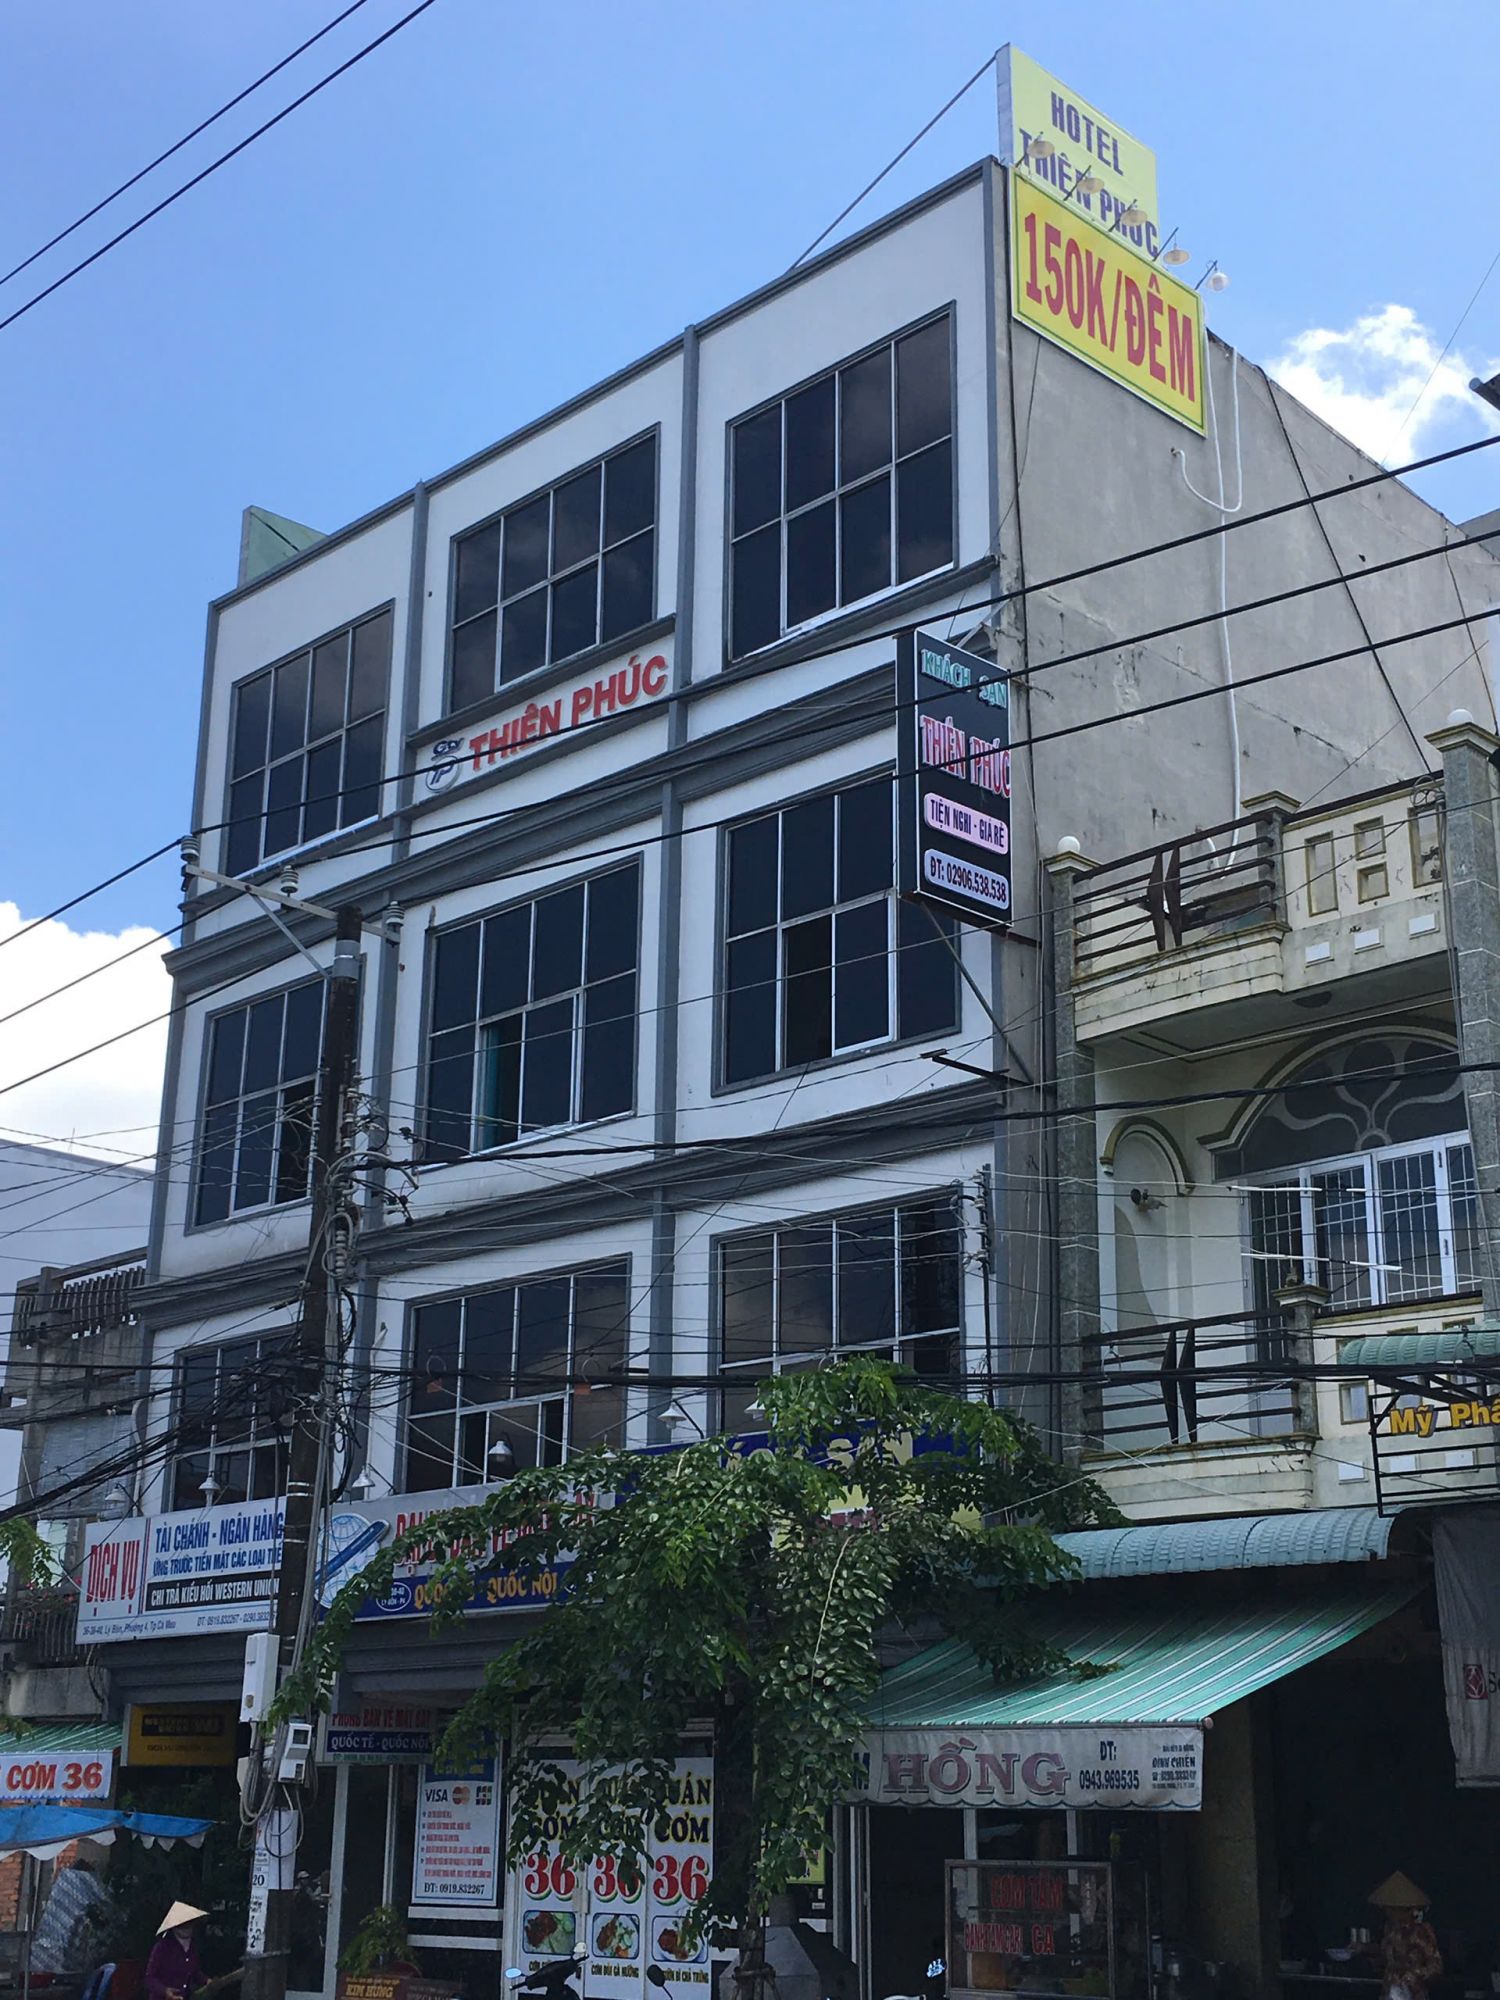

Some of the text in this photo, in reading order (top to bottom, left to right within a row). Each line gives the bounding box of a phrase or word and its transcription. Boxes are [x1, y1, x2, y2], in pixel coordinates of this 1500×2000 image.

[1051, 90, 1124, 176] HOTEL
[1024, 211, 1196, 403] 150K/ĐÊM
[921, 648, 1008, 709] KHÁCH SẠN
[469, 655, 668, 772] THIÊN PHÚC
[920, 715, 1011, 798] THIÊN PHÚC
[930, 799, 951, 829] TIỆN
[930, 856, 1007, 903] ĐT: 02906.538.538
[1390, 1406, 1433, 1437] Mỹ
[155, 1522, 172, 1553] TÀI
[174, 1518, 210, 1551] CHÁNH
[220, 1512, 251, 1546] NGÂN
[86, 1539, 140, 1617] DỊCH VỤ
[151, 1589, 165, 1606] CHI
[215, 1580, 252, 1600] WESTERN
[331, 1732, 360, 1750] QUỐC
[361, 1732, 376, 1748] TẾ
[6, 1760, 103, 1791] CƠM 36
[883, 1737, 1071, 1795] HỒNG
[1079, 1769, 1140, 1790] 0943.969535
[425, 1789, 448, 1802] VISA
[525, 1853, 576, 1898] 36
[653, 1855, 708, 1903] 36
